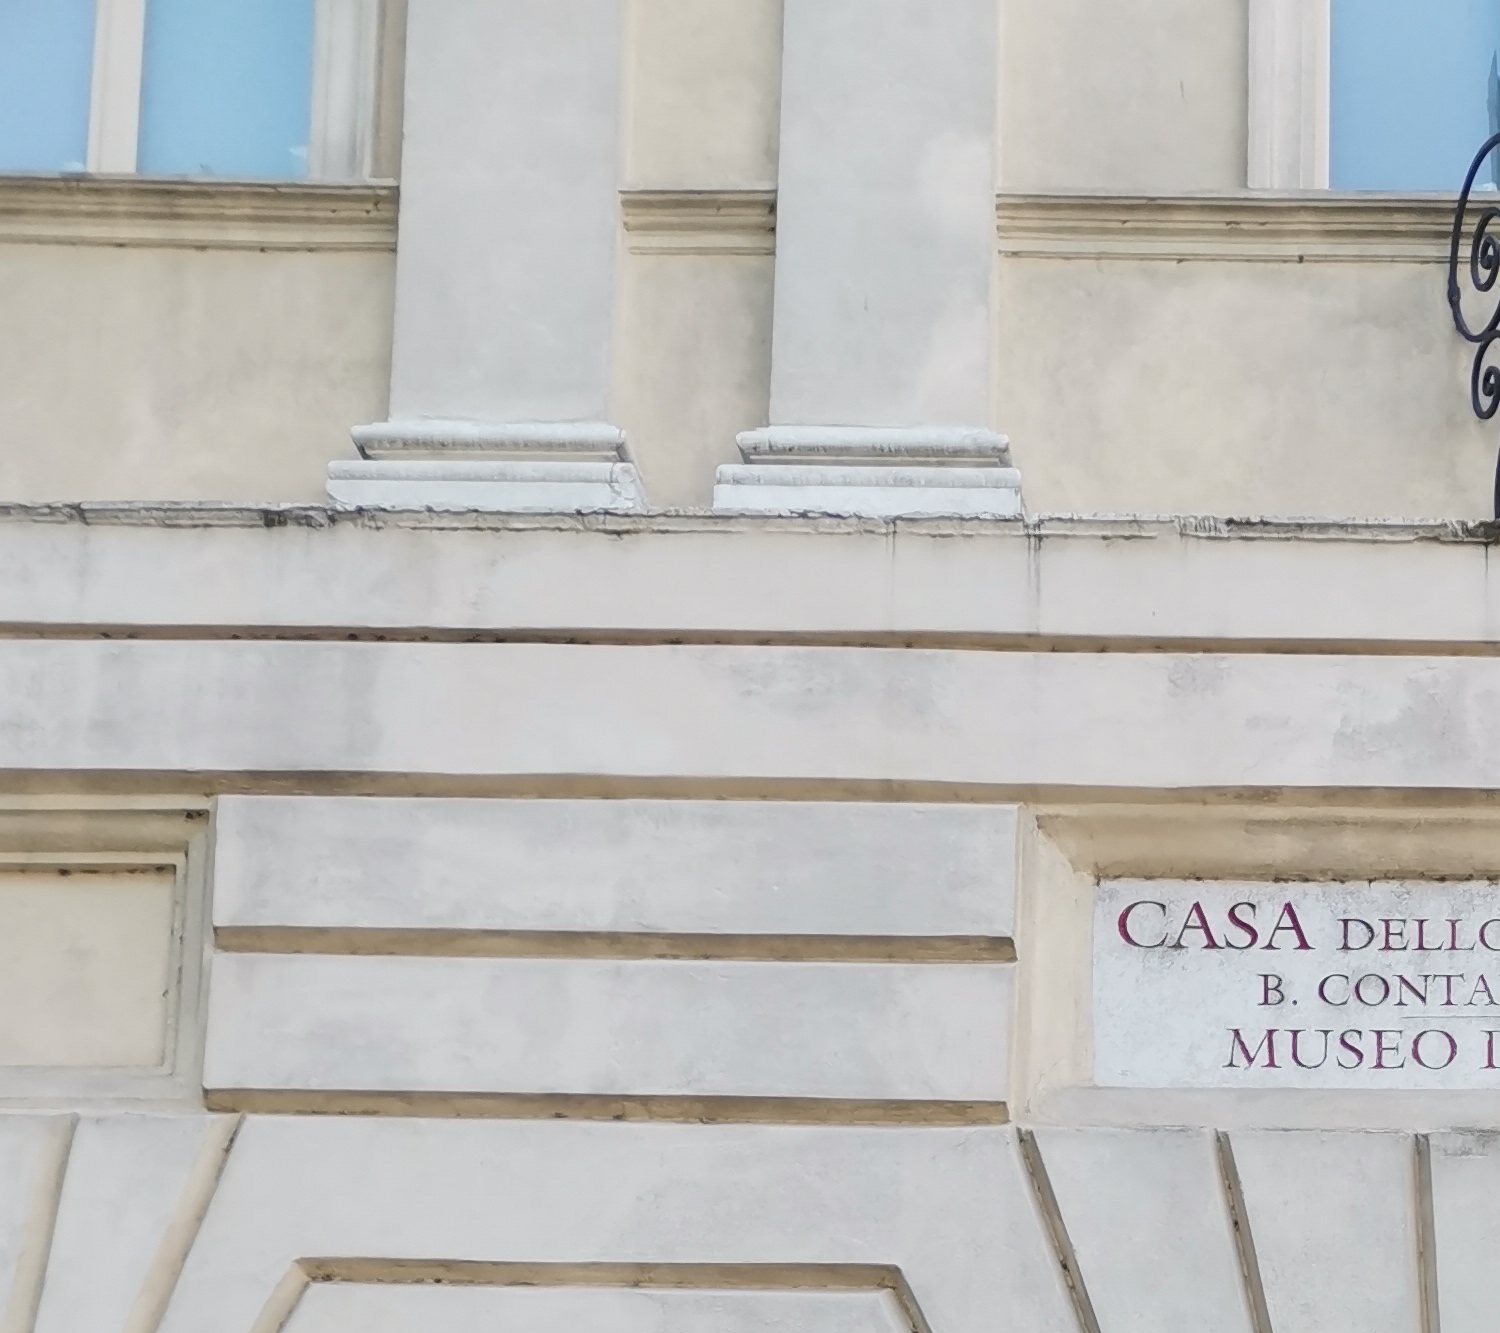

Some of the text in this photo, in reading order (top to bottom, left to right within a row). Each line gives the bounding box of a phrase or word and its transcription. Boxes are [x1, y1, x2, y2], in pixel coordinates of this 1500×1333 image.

[1117, 899, 1312, 952] CASA
[1257, 973, 1298, 1007] B.
[1222, 1028, 1458, 1070] MUSEO
